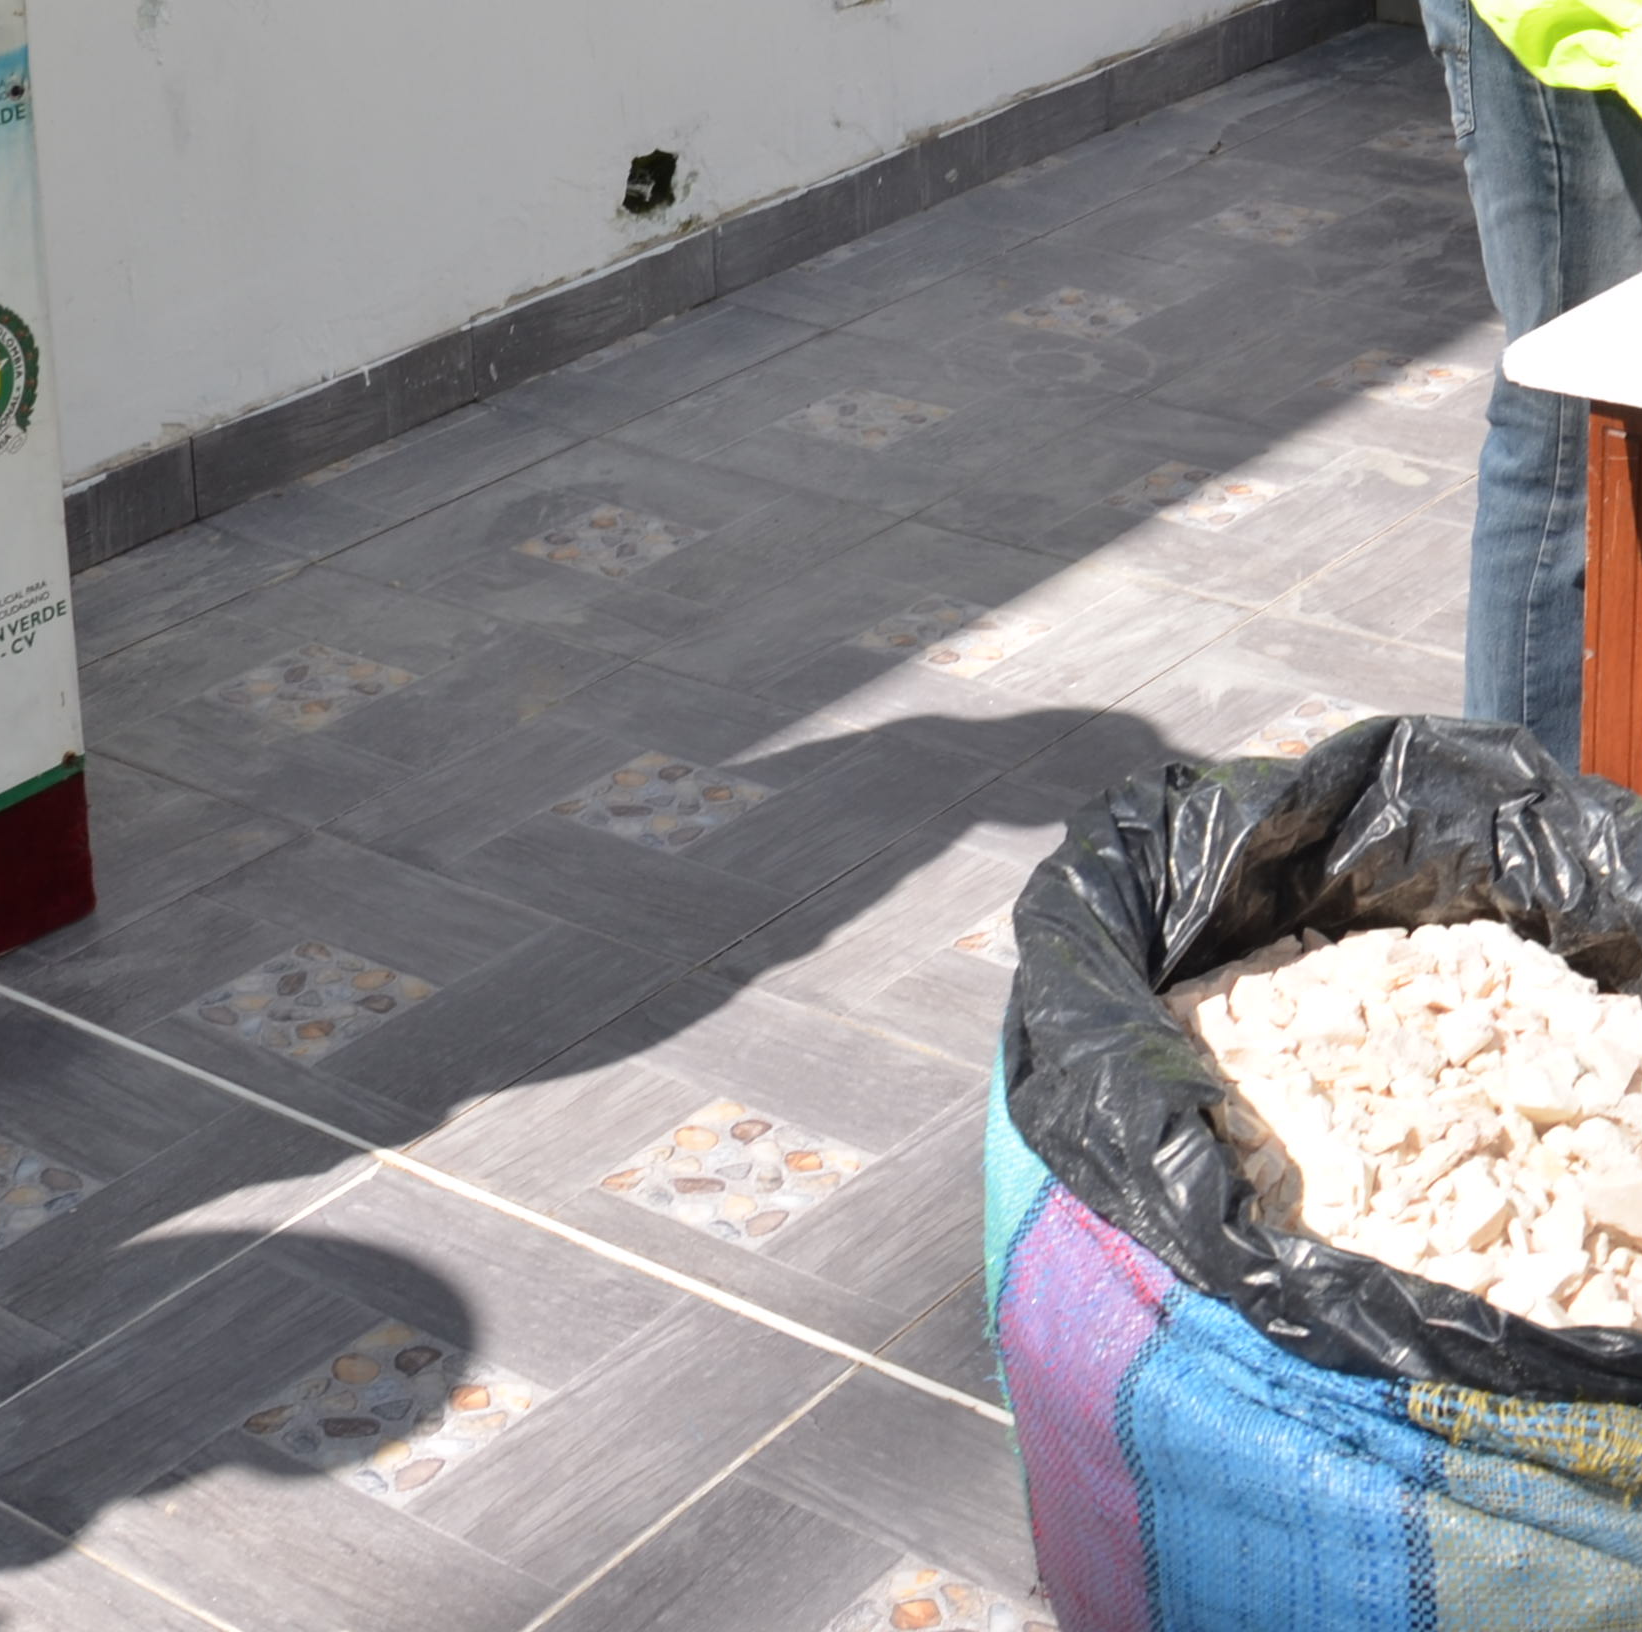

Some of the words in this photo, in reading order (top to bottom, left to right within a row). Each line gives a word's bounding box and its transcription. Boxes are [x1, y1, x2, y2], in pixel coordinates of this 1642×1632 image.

[27, 579, 47, 595] PARA
[7, 599, 67, 638] VERDE
[12, 631, 35, 656] CV
